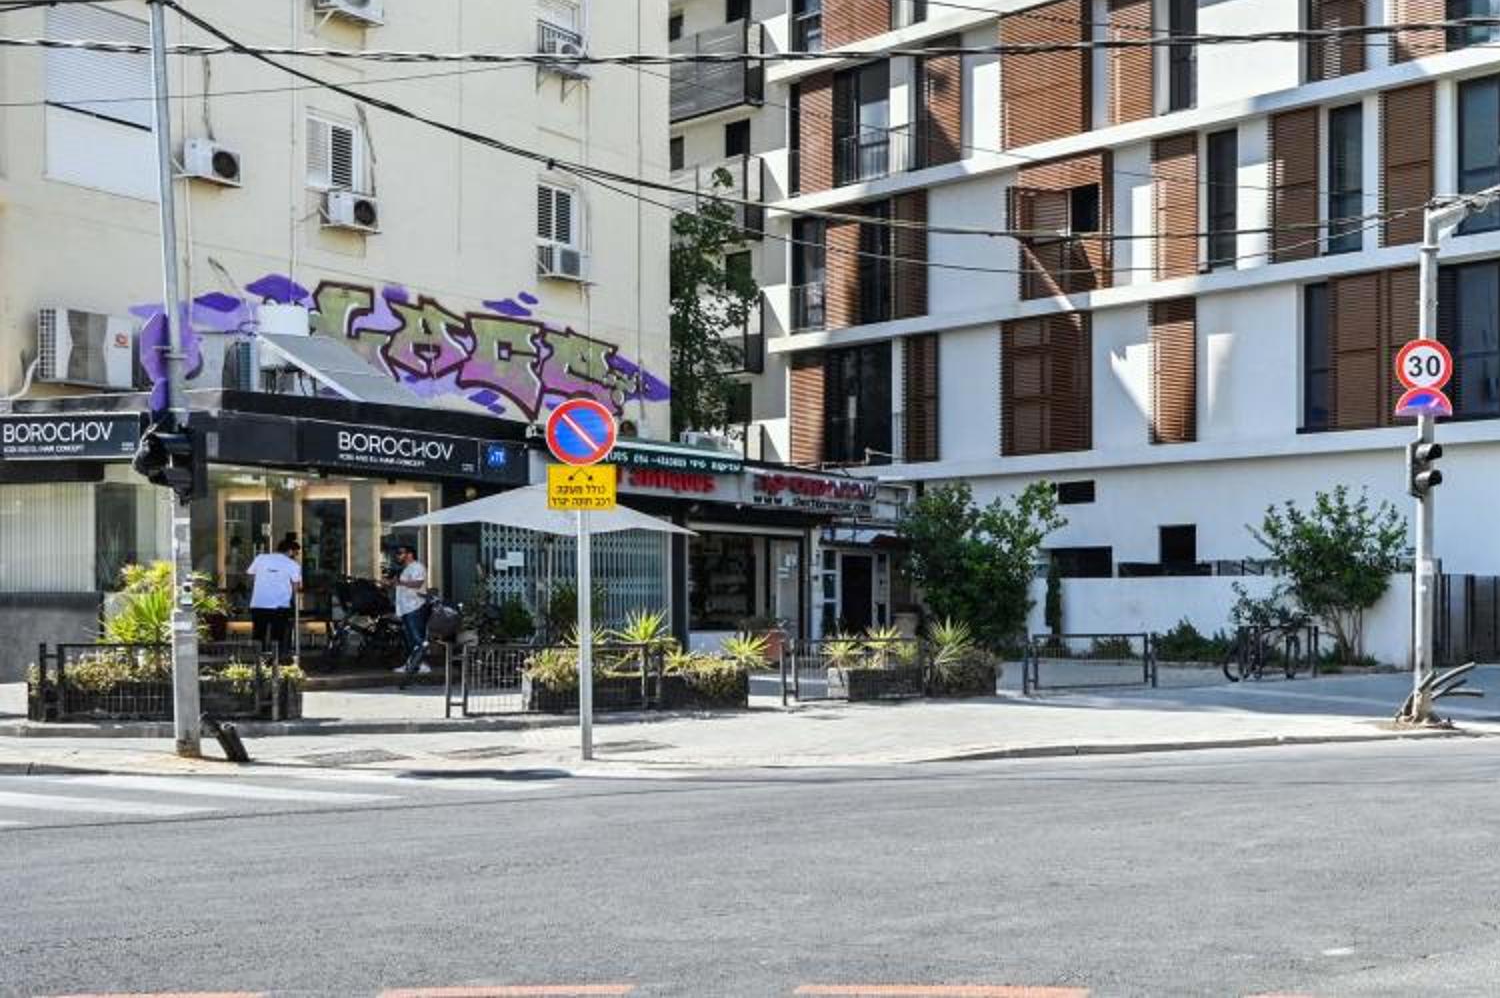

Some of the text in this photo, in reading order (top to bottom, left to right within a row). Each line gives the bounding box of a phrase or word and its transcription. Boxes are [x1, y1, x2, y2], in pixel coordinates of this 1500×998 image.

[1408, 355, 1441, 377] 30
[3, 422, 113, 442] BOROCHOV
[338, 432, 454, 461] BOROCHOV
